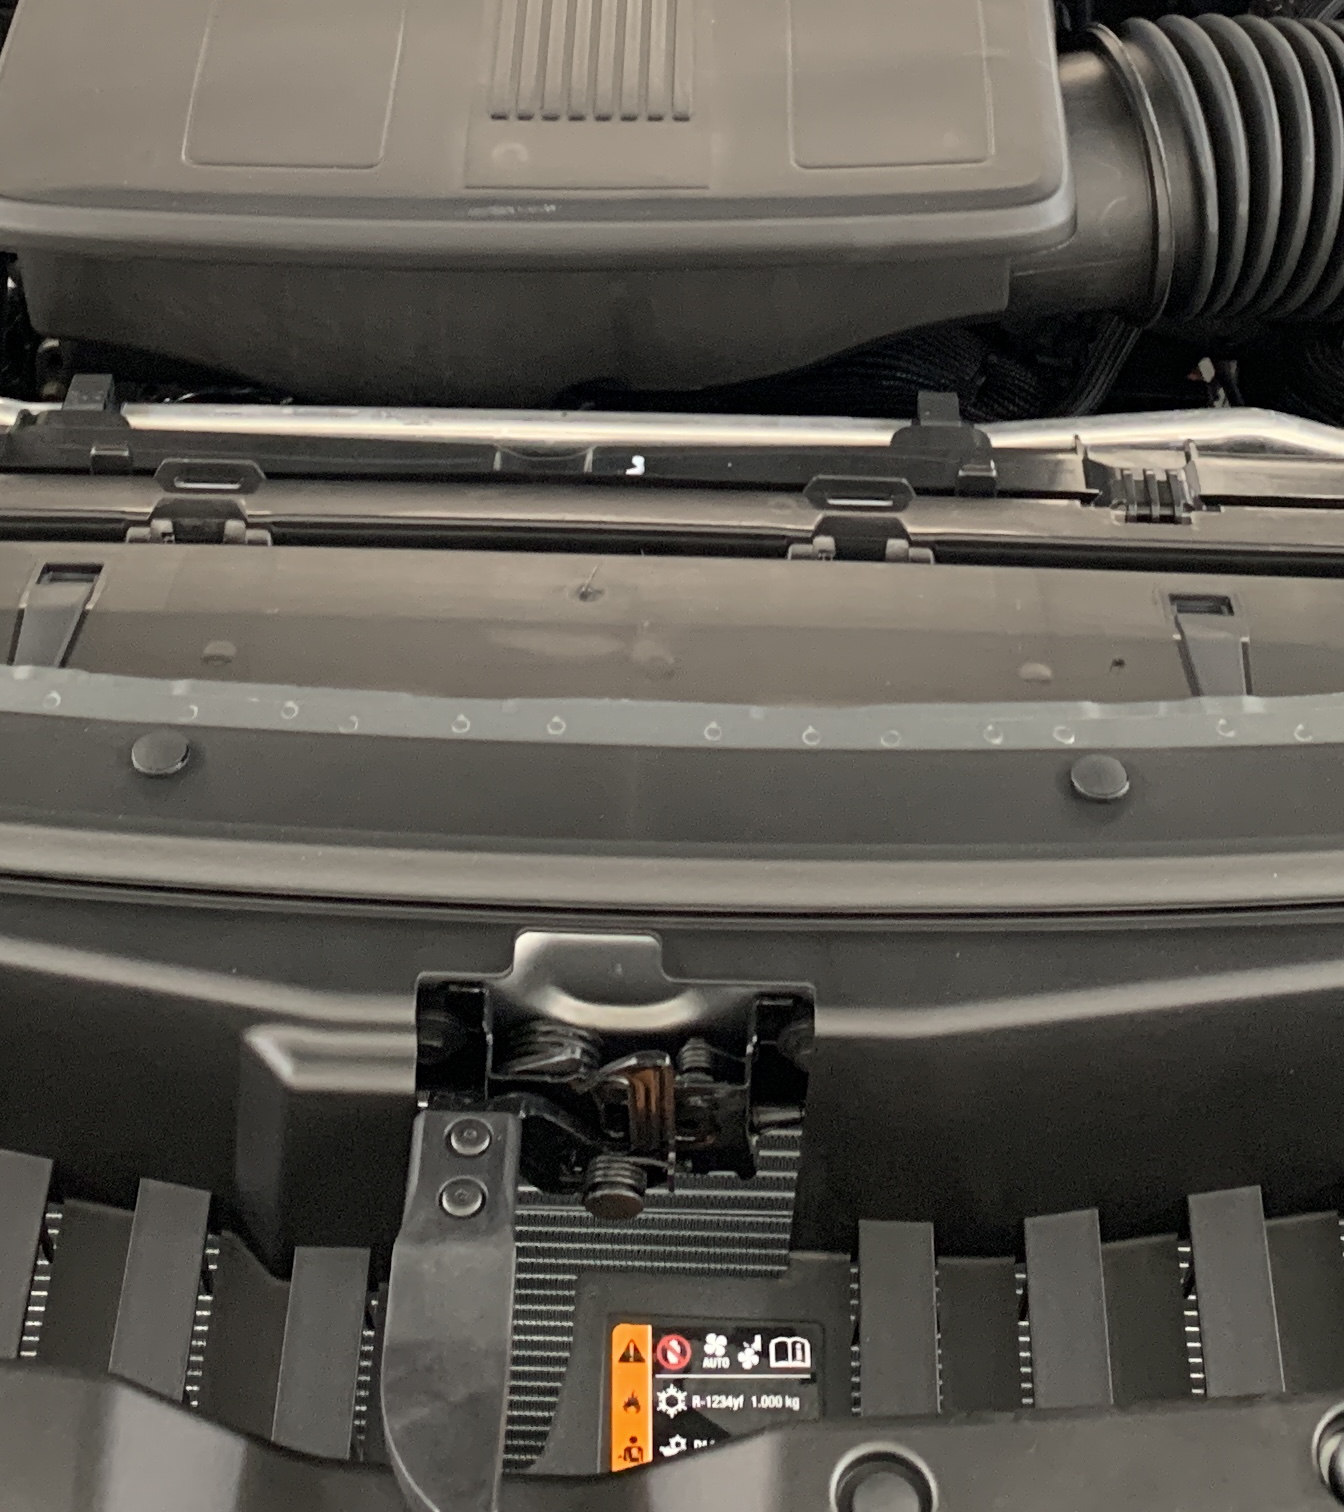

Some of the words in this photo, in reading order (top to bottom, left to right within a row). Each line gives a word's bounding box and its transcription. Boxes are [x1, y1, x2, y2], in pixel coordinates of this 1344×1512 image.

[702, 1356, 731, 1369] AUTO
[692, 1393, 745, 1411] R-1234yf
[750, 1394, 783, 1409] 1.000
[784, 1394, 801, 1411] kg
